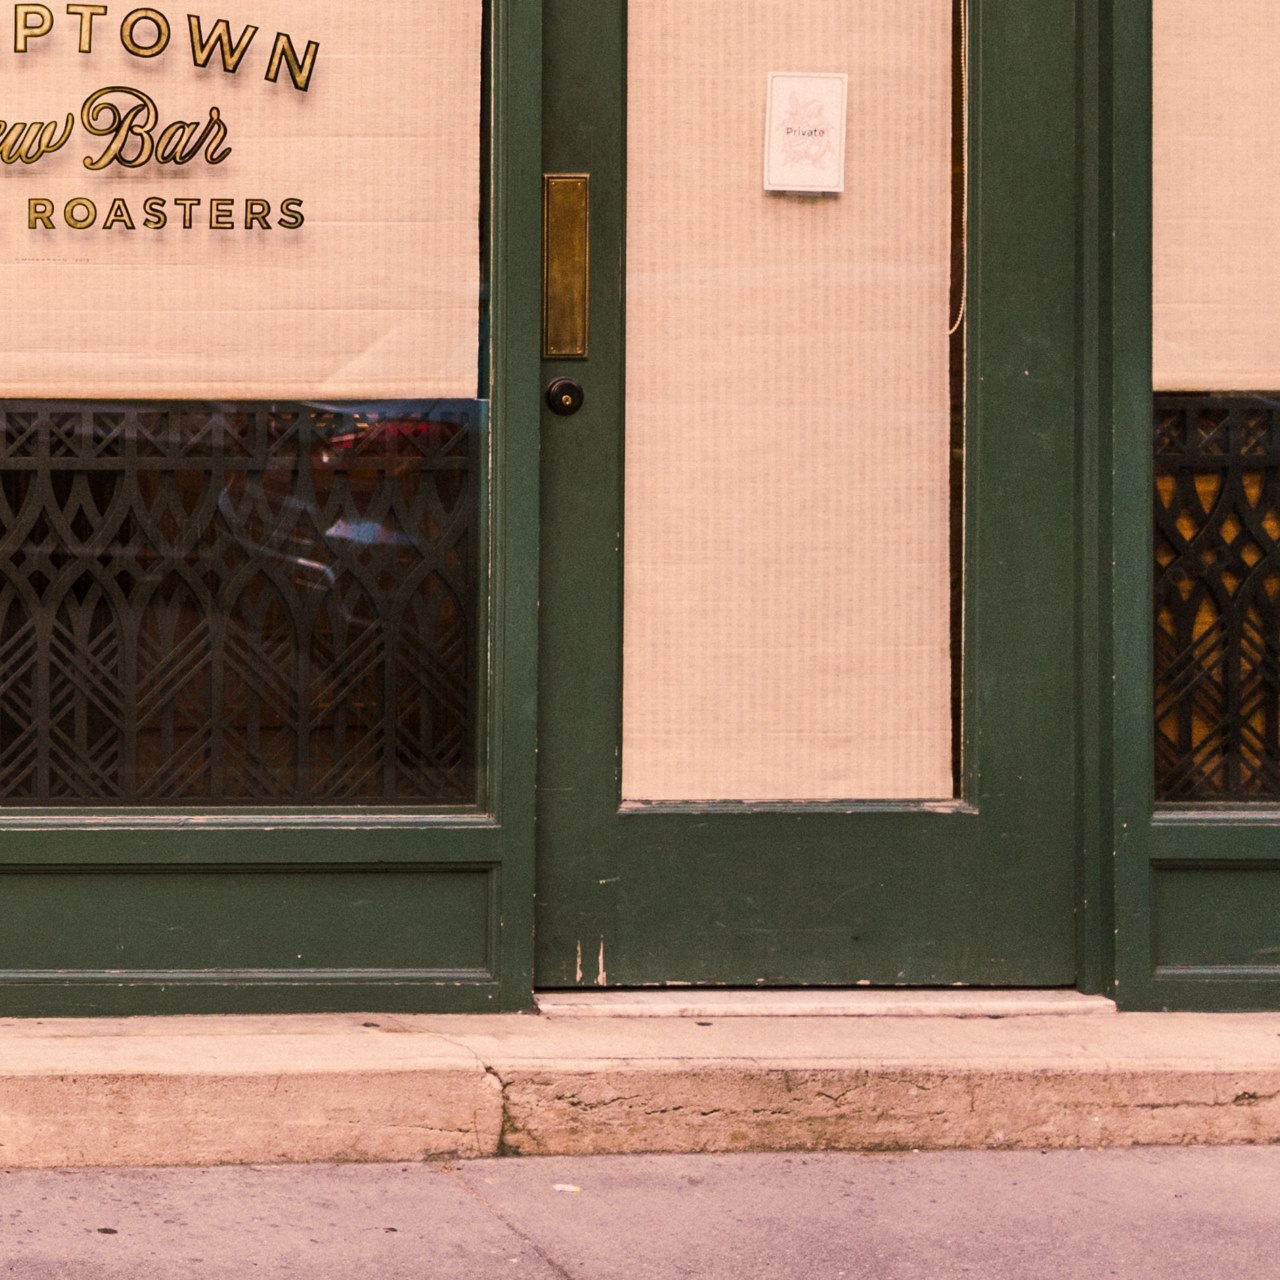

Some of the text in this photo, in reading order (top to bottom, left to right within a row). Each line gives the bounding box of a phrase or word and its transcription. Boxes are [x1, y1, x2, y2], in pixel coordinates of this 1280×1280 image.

[80, 86, 233, 170] Bar
[786, 127, 825, 137] Private
[27, 197, 306, 230] ROASTERS
